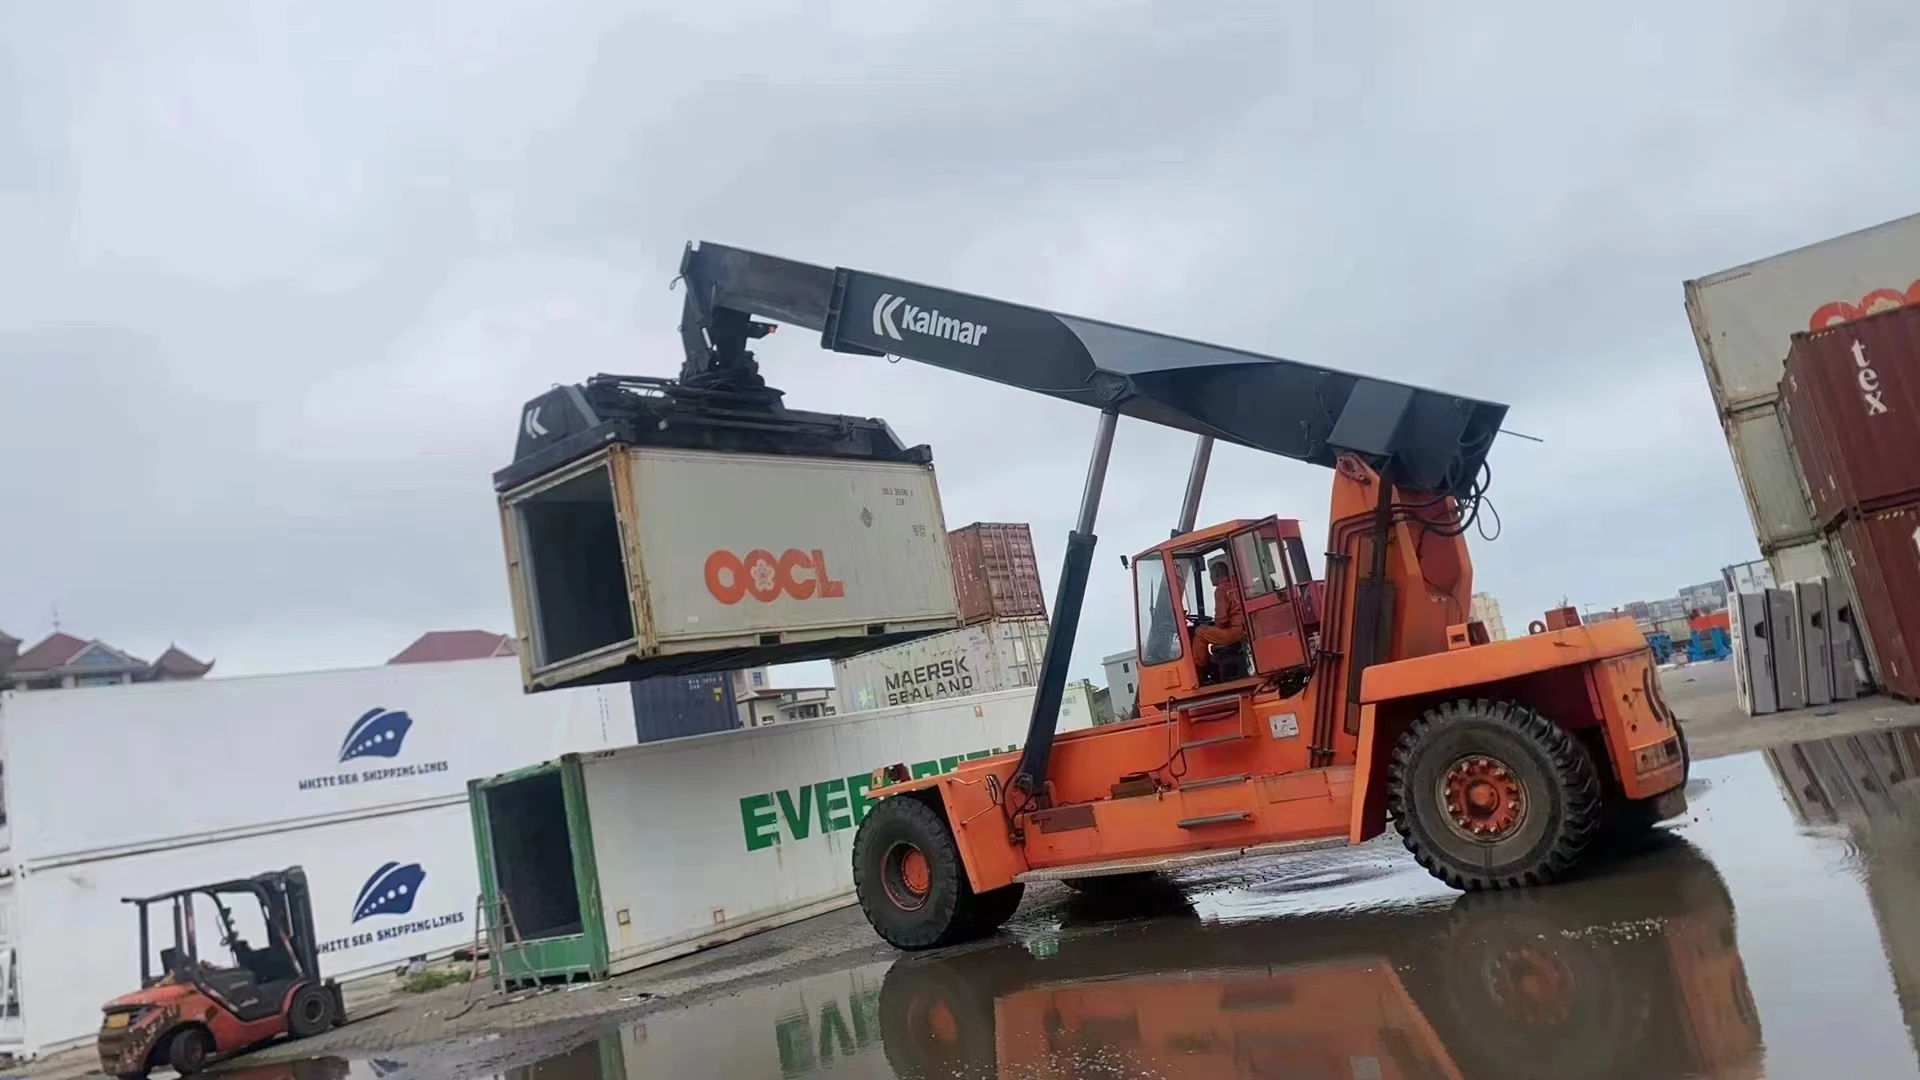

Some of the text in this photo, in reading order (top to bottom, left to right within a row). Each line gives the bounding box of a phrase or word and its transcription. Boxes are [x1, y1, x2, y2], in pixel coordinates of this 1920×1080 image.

[901, 304, 988, 346] Kalmar
[1851, 338, 1889, 417] tex
[704, 549, 845, 605] OOCL
[885, 656, 970, 692] MAERSK
[887, 675, 974, 706] SEALAND
[299, 760, 449, 791] WHITE SEA SHIPPING LINES
[351, 931, 374, 948] SEA
[376, 920, 431, 941] SHIPPING
[432, 911, 464, 928] LINES
